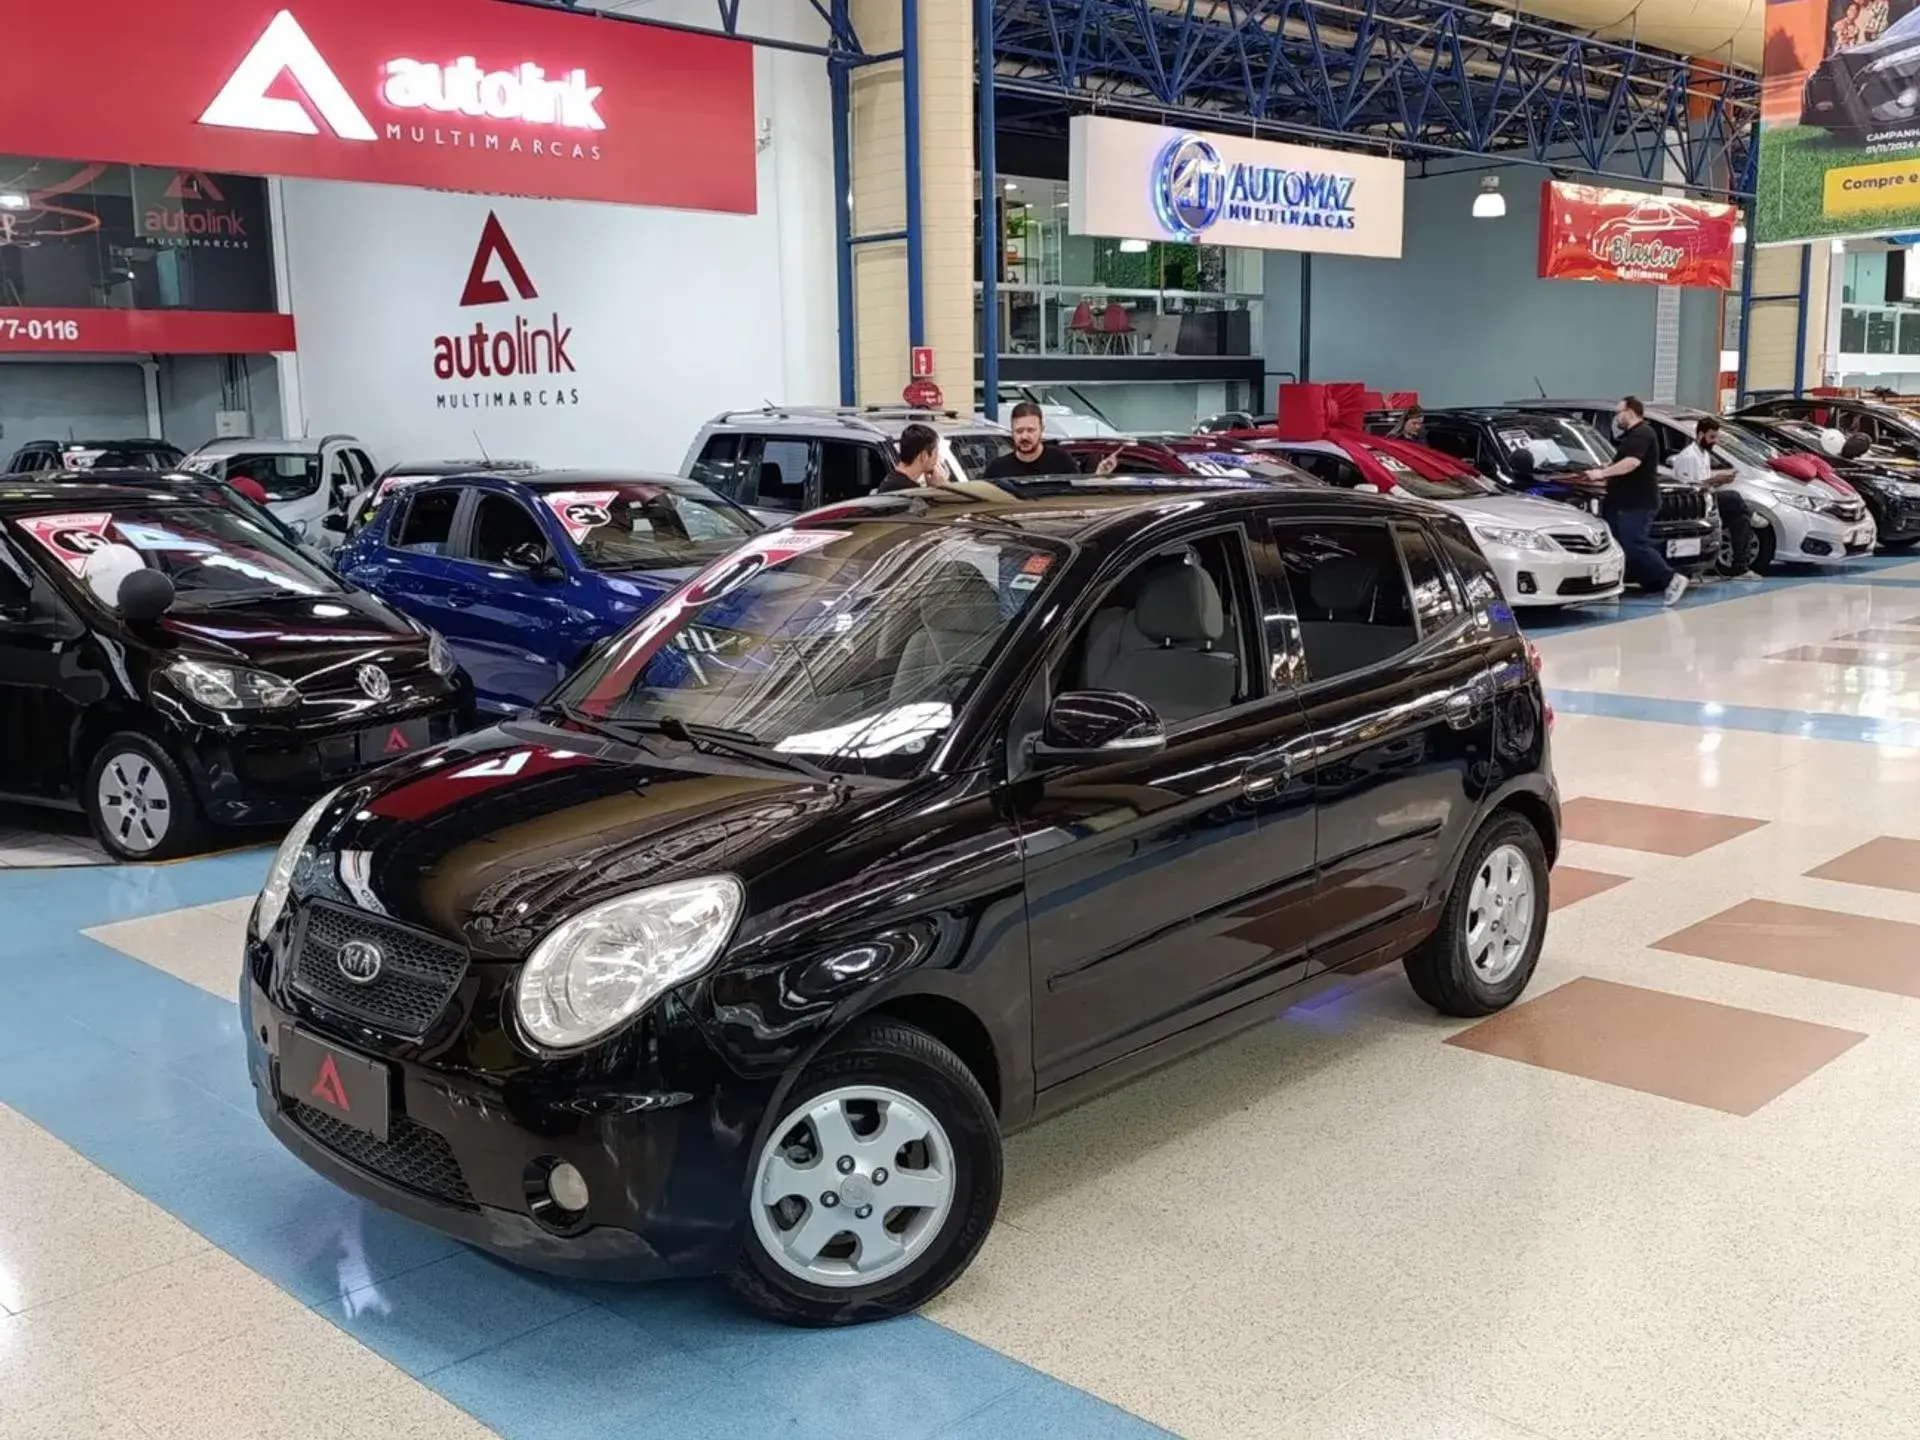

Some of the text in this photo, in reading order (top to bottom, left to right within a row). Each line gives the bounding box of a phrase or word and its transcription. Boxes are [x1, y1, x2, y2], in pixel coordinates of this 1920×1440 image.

[384, 56, 606, 130] autolink
[386, 123, 601, 160] MULTIMARCAS
[1866, 128, 1920, 142] CAMPANH
[1228, 162, 1356, 211] AUTOMAZ
[1842, 174, 1919, 190] Compre e
[145, 208, 247, 236] autolink
[1228, 204, 1355, 229] MULTIMARCAS
[146, 237, 249, 250] MULTIMARCAS
[1611, 231, 1684, 270] BlasCar
[434, 312, 576, 380] autolink
[436, 388, 580, 409] MULTIMARCAS
[569, 506, 608, 524] 24
[63, 531, 108, 551] 16
